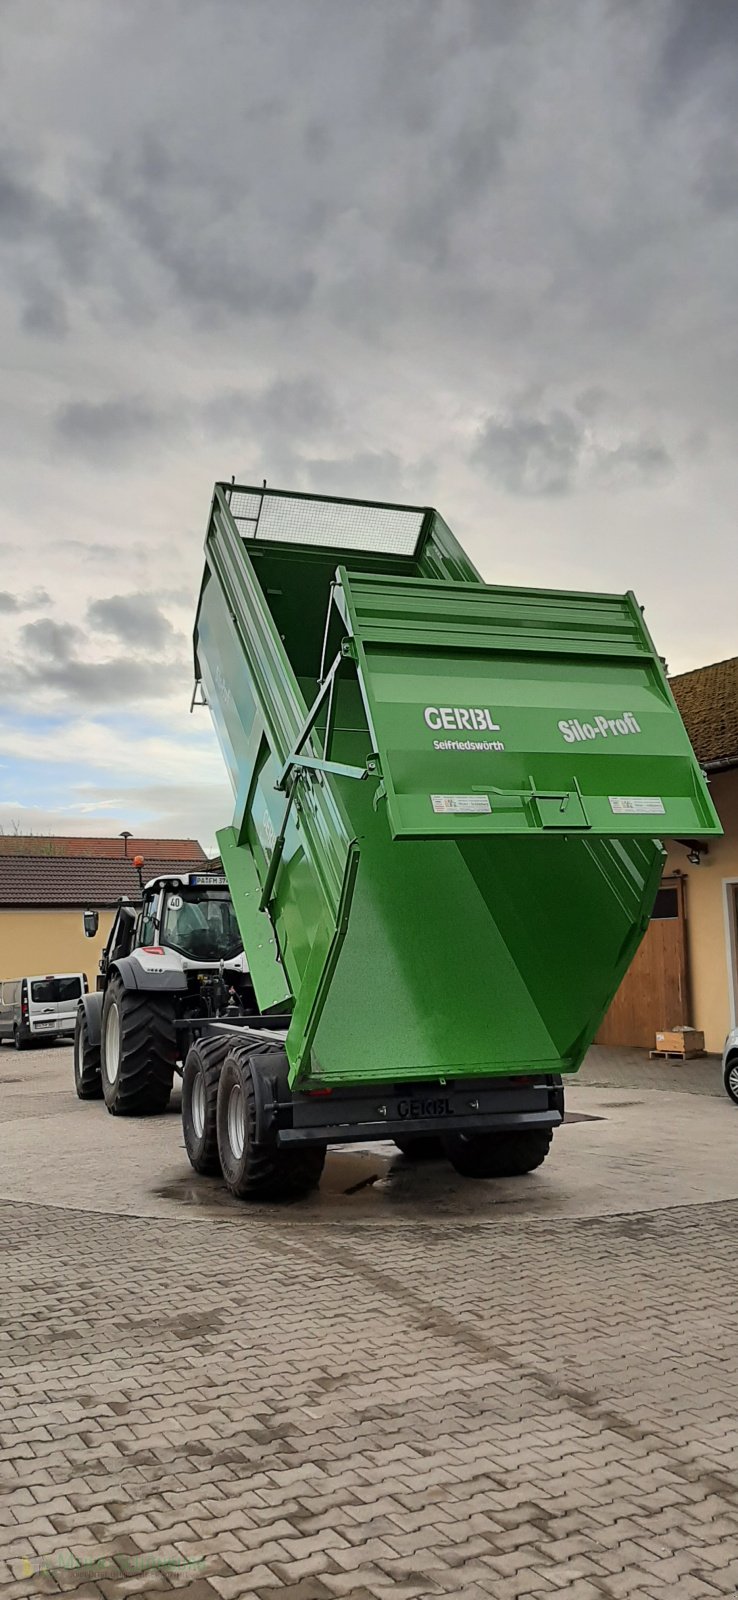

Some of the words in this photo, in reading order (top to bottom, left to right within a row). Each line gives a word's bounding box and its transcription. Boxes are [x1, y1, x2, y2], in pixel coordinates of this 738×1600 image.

[424, 707, 500, 730] GERBL
[558, 712, 641, 743] Silo-Profi
[433, 741, 504, 751] Seifriedswörth
[170, 898, 180, 907] 40
[397, 1099, 454, 1117] GERBL
